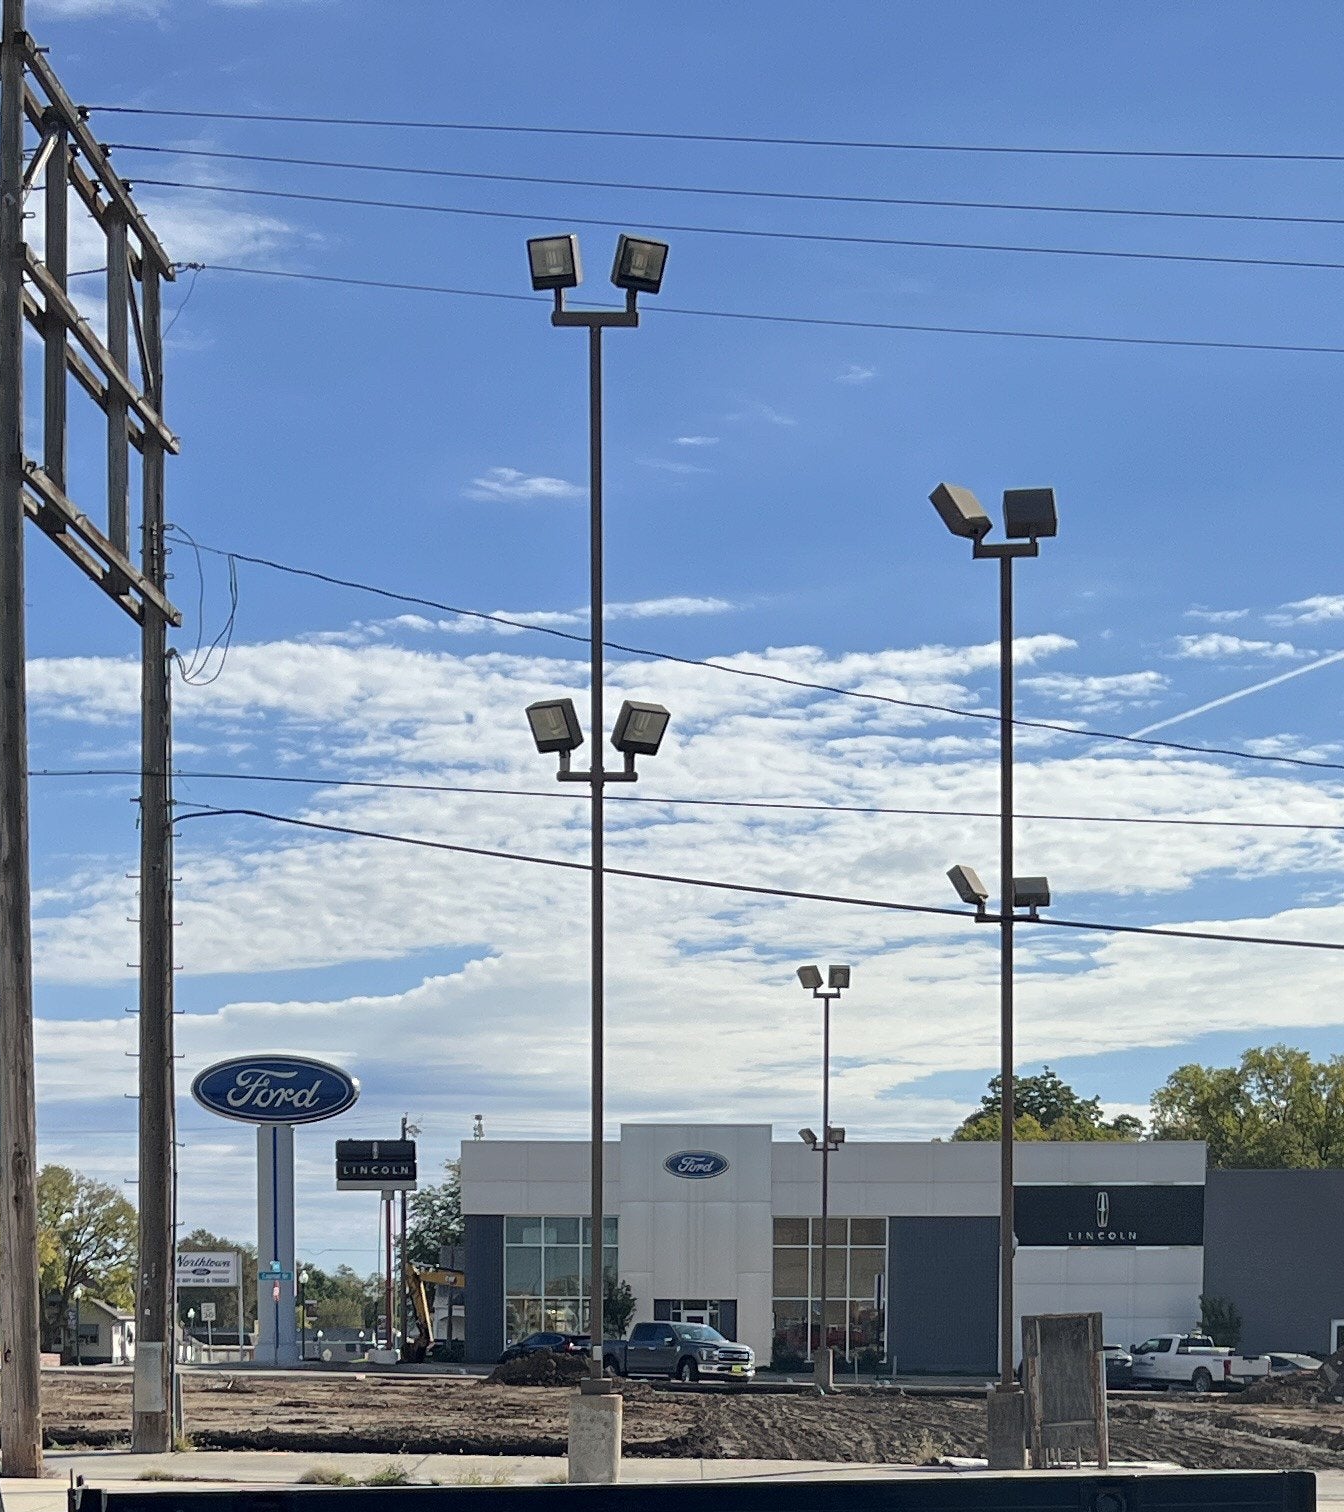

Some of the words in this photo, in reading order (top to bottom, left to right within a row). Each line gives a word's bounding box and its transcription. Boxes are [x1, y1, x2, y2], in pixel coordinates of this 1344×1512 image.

[227, 1068, 322, 1108] Ford
[343, 1165, 409, 1175] LINCOLN
[677, 1156, 715, 1173] Ford
[1068, 1231, 1137, 1241] LINCOLN
